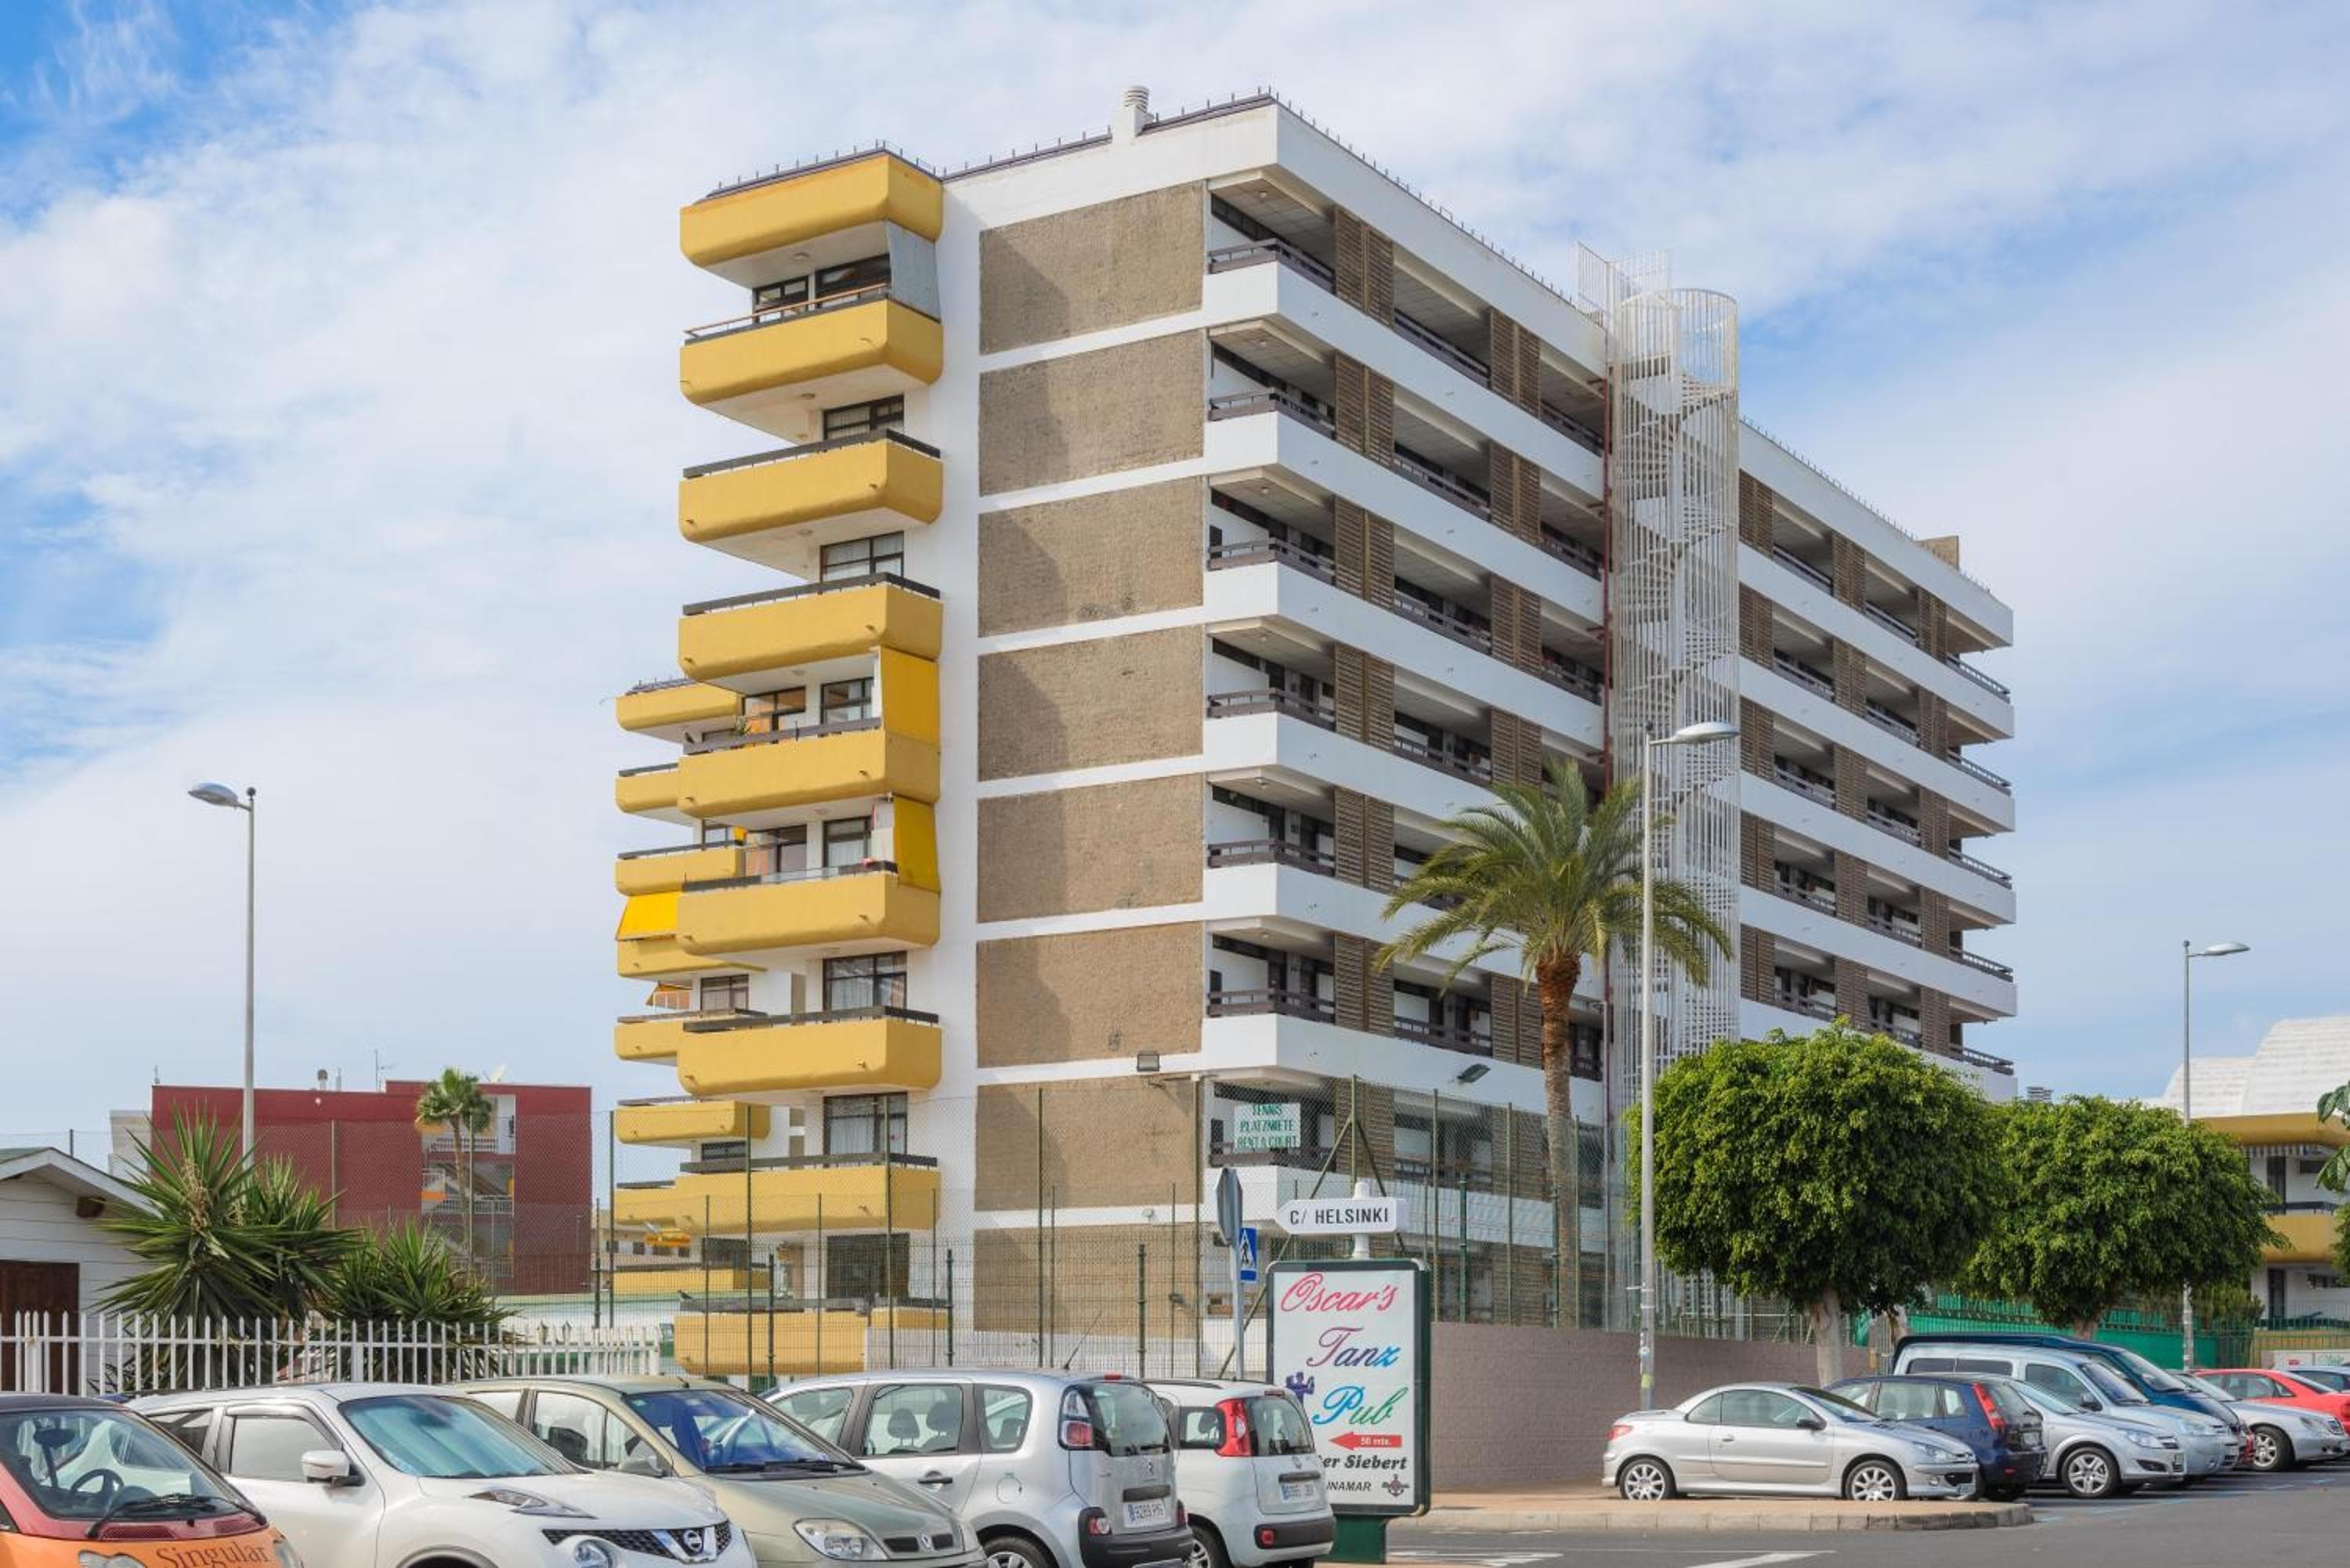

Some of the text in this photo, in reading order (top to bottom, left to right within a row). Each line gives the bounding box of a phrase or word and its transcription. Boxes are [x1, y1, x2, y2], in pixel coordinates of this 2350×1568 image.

[1253, 1104, 1282, 1116] TENNIS
[1238, 1136, 1259, 1149] RENT
[1268, 1136, 1297, 1149] COURT
[1289, 1207, 1389, 1225] C/ HELSINKI
[1280, 1272, 1398, 1313] Oscar's
[1306, 1325, 1401, 1368] Tanz
[1312, 1385, 1409, 1425] Pub
[1318, 1454, 1408, 1470] er Siebert
[156, 1541, 272, 1568] Singular
